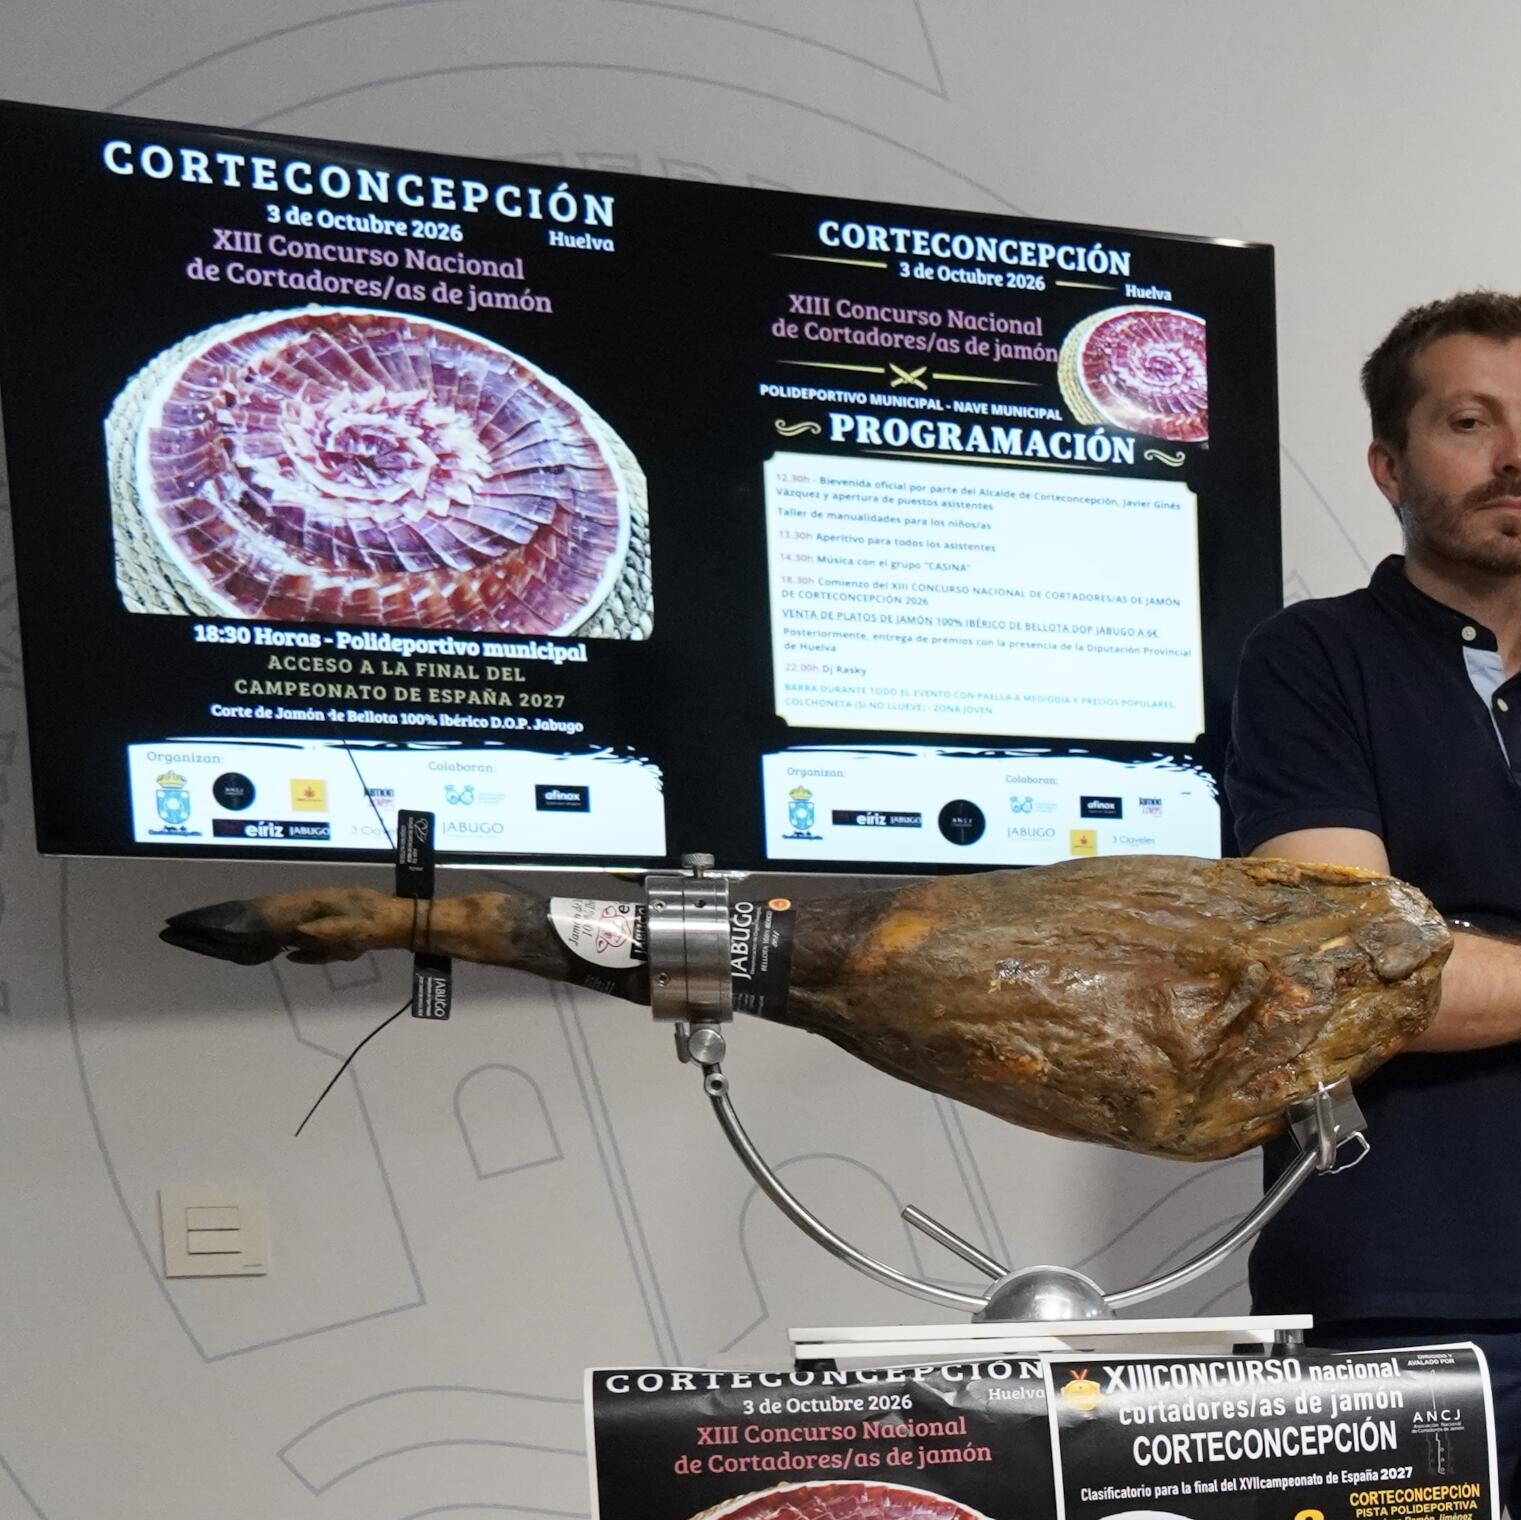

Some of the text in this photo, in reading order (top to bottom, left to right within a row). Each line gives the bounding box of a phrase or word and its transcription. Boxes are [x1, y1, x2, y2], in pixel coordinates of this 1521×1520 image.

[102, 139, 616, 228] CORTECONCEPCIÓN
[266, 204, 463, 243] 3 de Octubre 2026
[548, 229, 615, 252] Huelva
[212, 228, 525, 281] XIII Concurso Nacional
[818, 220, 1131, 276] CORTECONCEPCIÓN
[186, 256, 553, 314] de Cortadores/as de jamón
[899, 261, 1045, 291] 3 de Octubre 2026
[1124, 283, 1172, 301] Huelva
[788, 294, 1043, 337] XIII Concurso Nacional
[759, 383, 1063, 421] POLIDEPORTIVO MUNICIPAL NAVE MUNICIPAL
[828, 412, 1136, 464] PROGRAMACIÓN
[811, 510, 823, 519] de
[826, 511, 901, 524] manualidades
[904, 517, 928, 529] para
[816, 554, 854, 566] Música
[194, 624, 589, 665] 18:30 Horas Polideportivo municipal
[729, 901, 754, 980] JABUGO
[989, 1386, 1045, 1401] Huelva
[1103, 1357, 1401, 1394] XIIICONCURSO nacional
[743, 1393, 913, 1415] 3 de Octubre 2026
[1119, 1384, 1404, 1425] cortadores/as de jamón
[697, 1416, 967, 1446] XIII Concurso Nacional
[1133, 1415, 1398, 1467] CORTECONCEPCIÓN
[674, 1441, 993, 1475] de Cortadores/as de jamón
[1080, 1484, 1152, 1502] Clasificatorio
[1155, 1482, 1179, 1499] para
[1181, 1480, 1192, 1495] la
[1194, 1479, 1218, 1494] final
[1220, 1478, 1237, 1492] del
[1326, 1471, 1339, 1485] de
[1341, 1468, 1379, 1486] España
[1380, 1466, 1414, 1481] 2027
[1350, 1482, 1481, 1507] CORTECONCEPCIÓN
[1356, 1499, 1478, 1519] PISTA POLIDEPORTIVA
